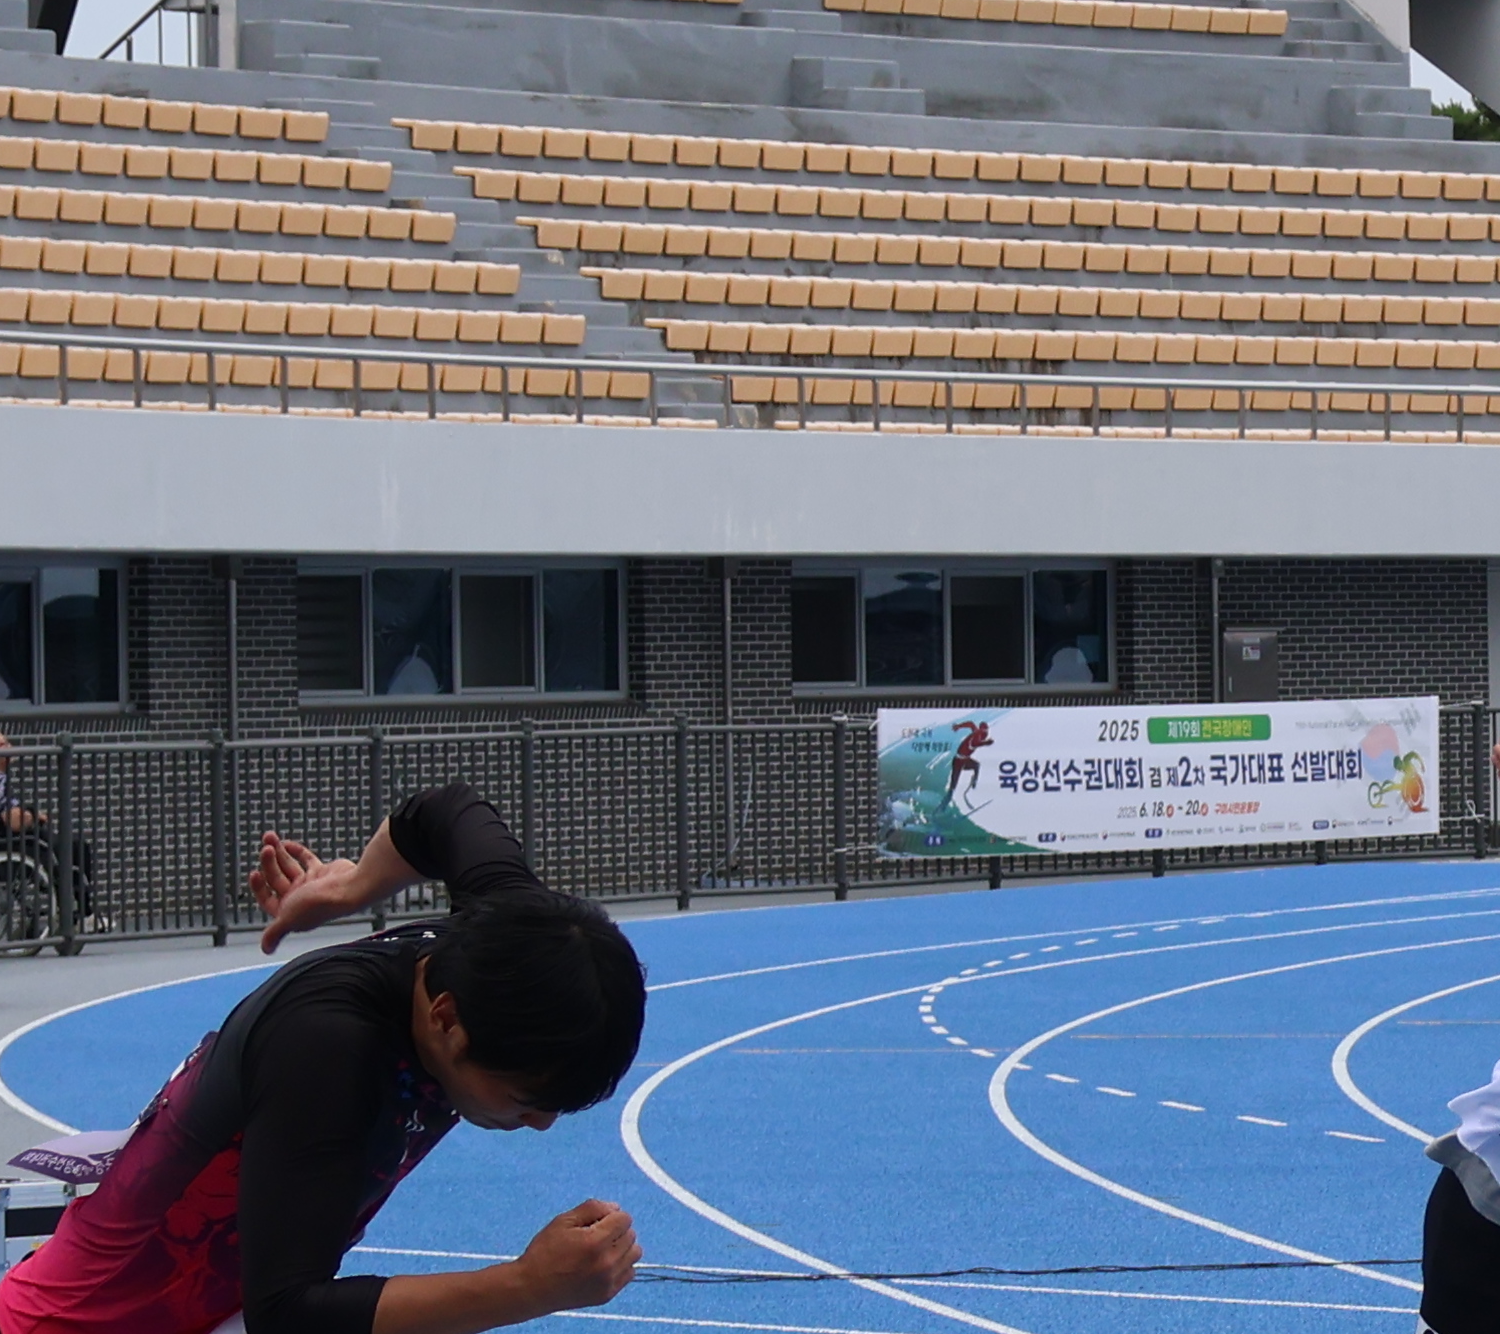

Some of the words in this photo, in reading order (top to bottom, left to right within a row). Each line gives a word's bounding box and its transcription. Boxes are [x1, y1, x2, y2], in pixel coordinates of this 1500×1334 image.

[1098, 720, 1140, 742] 2025
[1167, 720, 1200, 740] 제19회
[1202, 718, 1252, 739] 전국장애인
[998, 757, 1144, 794] 육상선수권대회
[1150, 766, 1162, 788] 겸
[1166, 756, 1206, 787] 제2차
[1209, 752, 1286, 786] 국가대표
[1290, 748, 1363, 783] 선발대회
